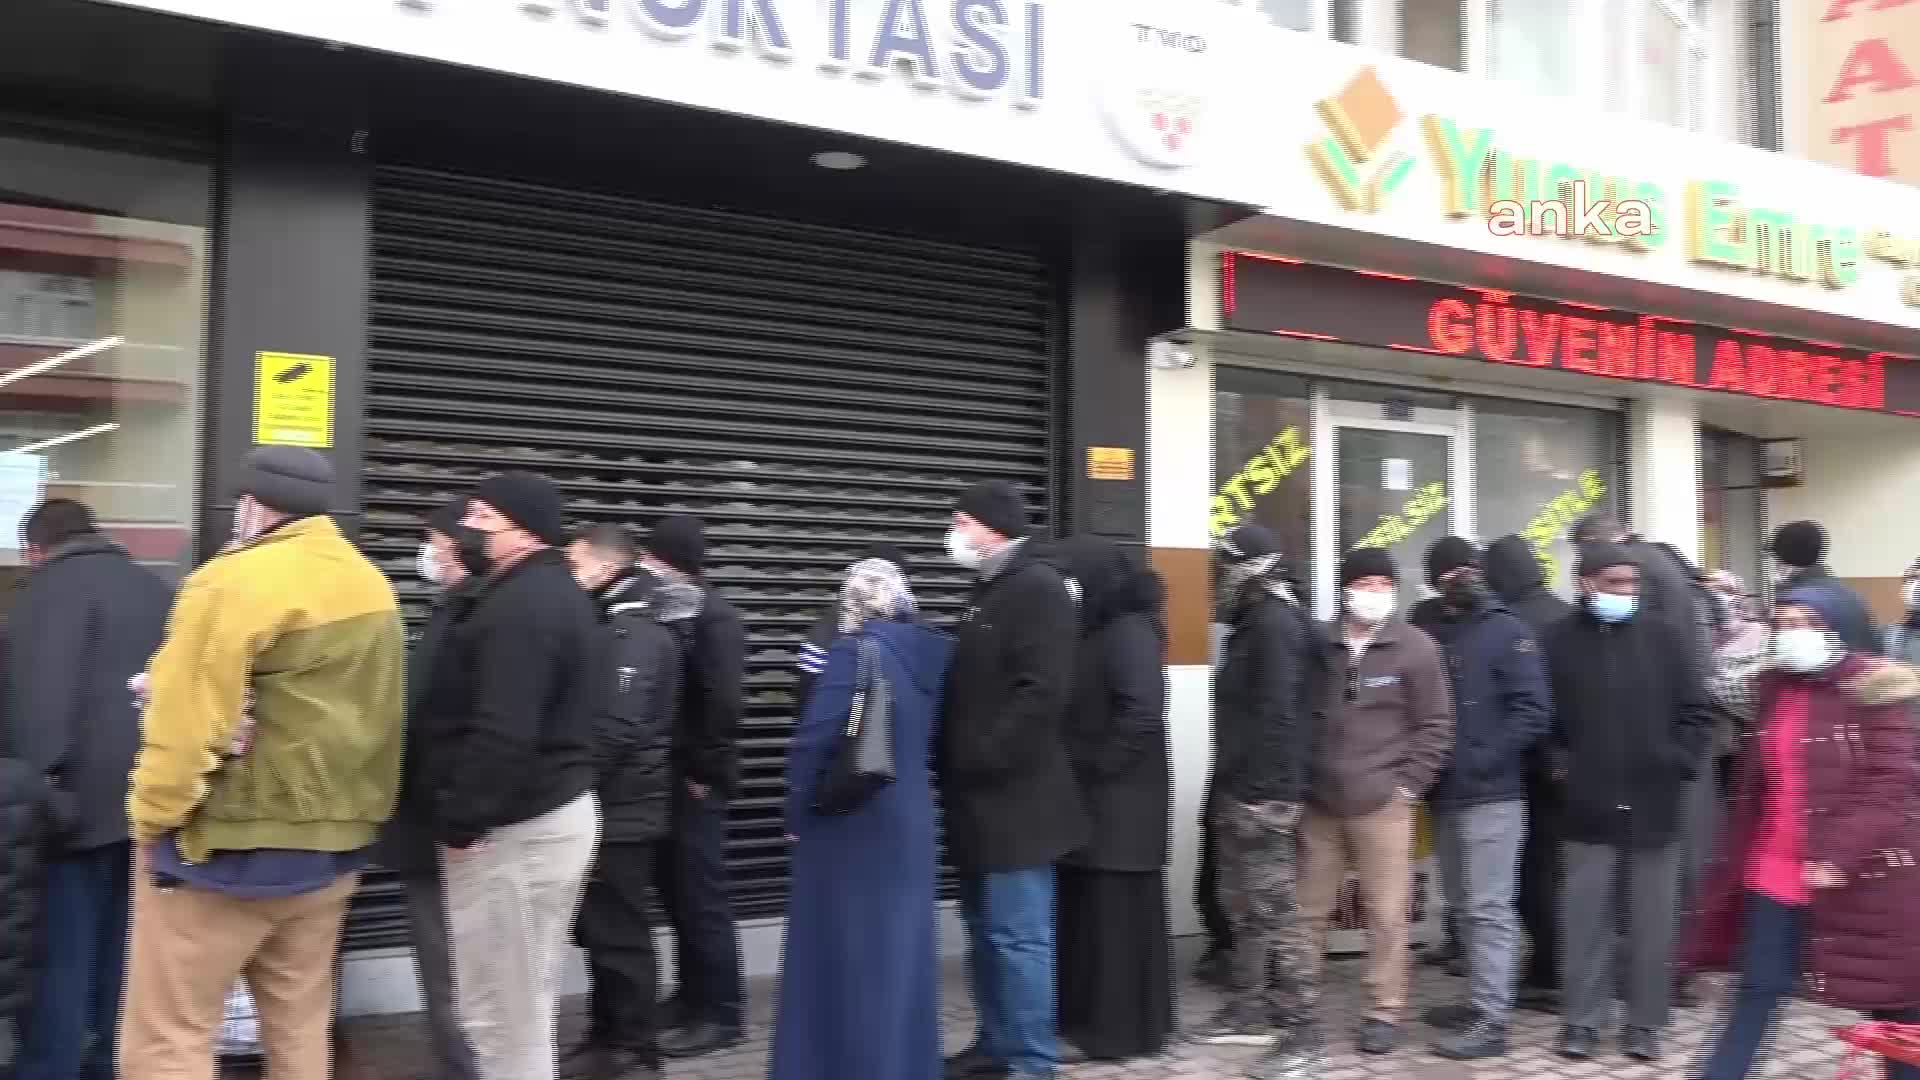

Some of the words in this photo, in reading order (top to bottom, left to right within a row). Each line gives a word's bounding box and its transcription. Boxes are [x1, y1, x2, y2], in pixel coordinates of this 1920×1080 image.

[1687, 180, 1859, 290] Emre
[1428, 288, 1697, 386] GÜVENİN
[1709, 338, 1887, 411] ADRESİ
